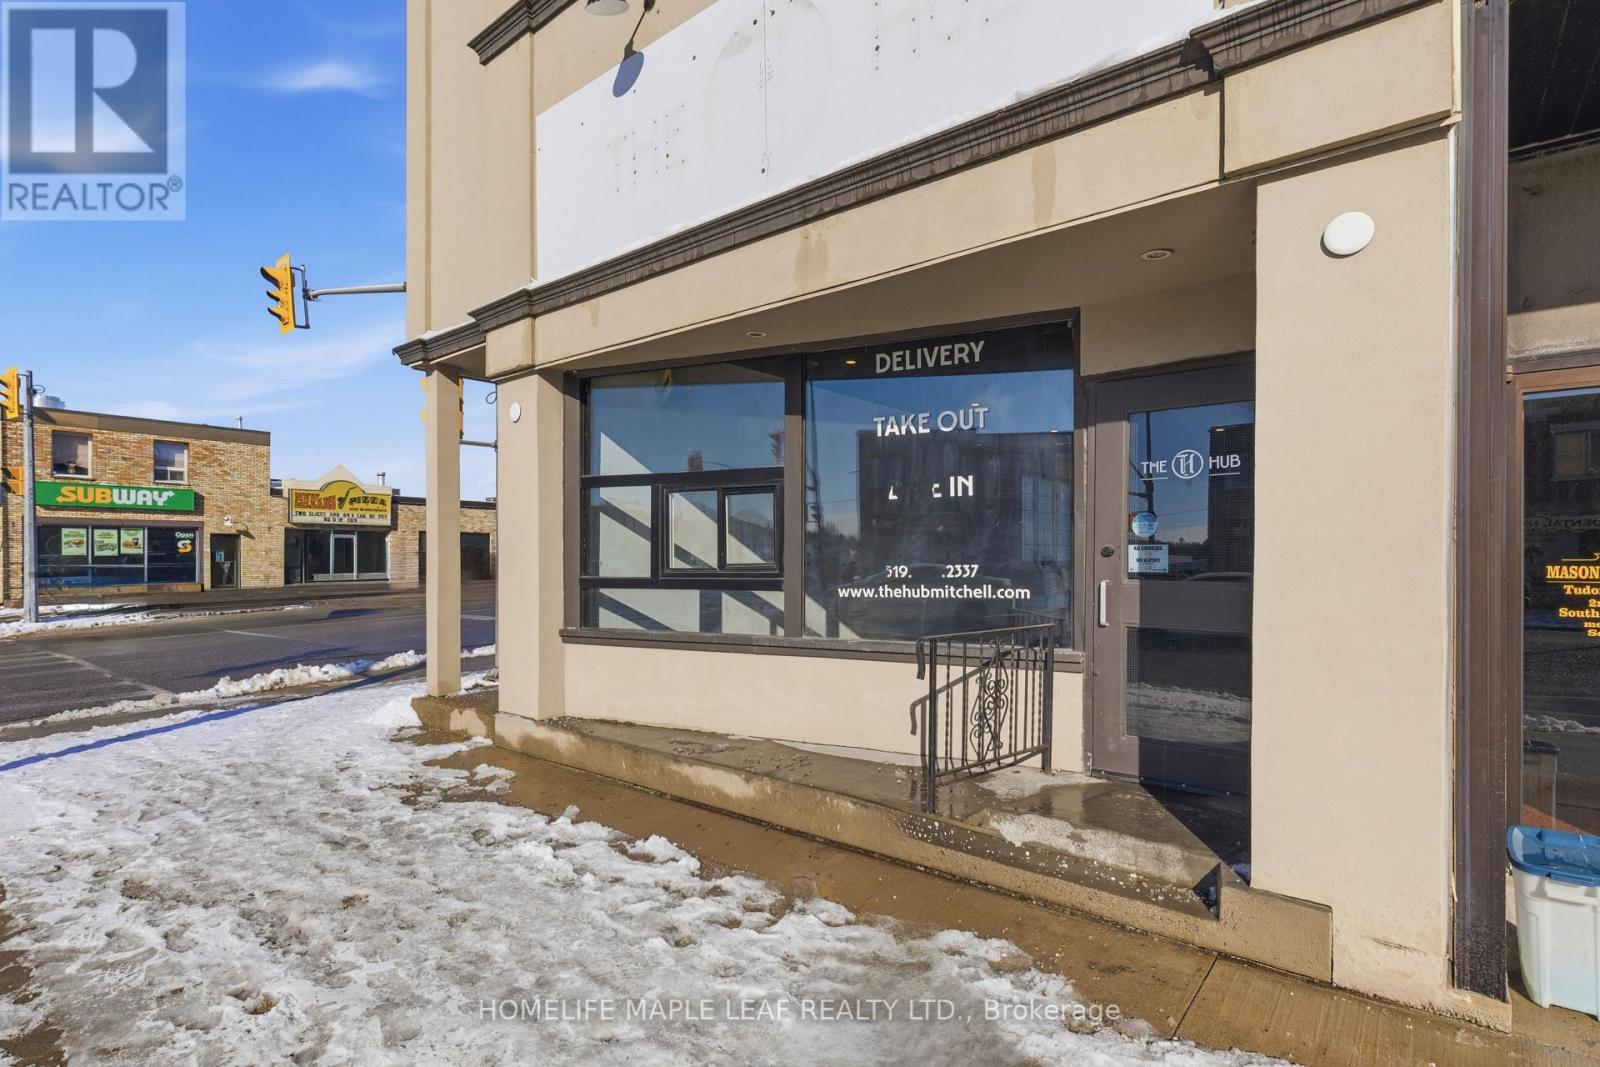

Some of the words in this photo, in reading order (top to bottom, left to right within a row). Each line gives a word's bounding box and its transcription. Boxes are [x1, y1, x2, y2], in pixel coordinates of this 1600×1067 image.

[875, 340, 985, 374] DELIVERY
[873, 412, 930, 437] TAKE
[937, 406, 989, 432] OUT
[1141, 460, 1167, 474] THE
[1209, 454, 1241, 470] HUB
[949, 475, 974, 497] IN
[55, 486, 175, 507] SUBWAY
[348, 496, 387, 507] PIZZA
[175, 531, 194, 539] Open
[838, 584, 1031, 600] www.thehubmitchell.com
